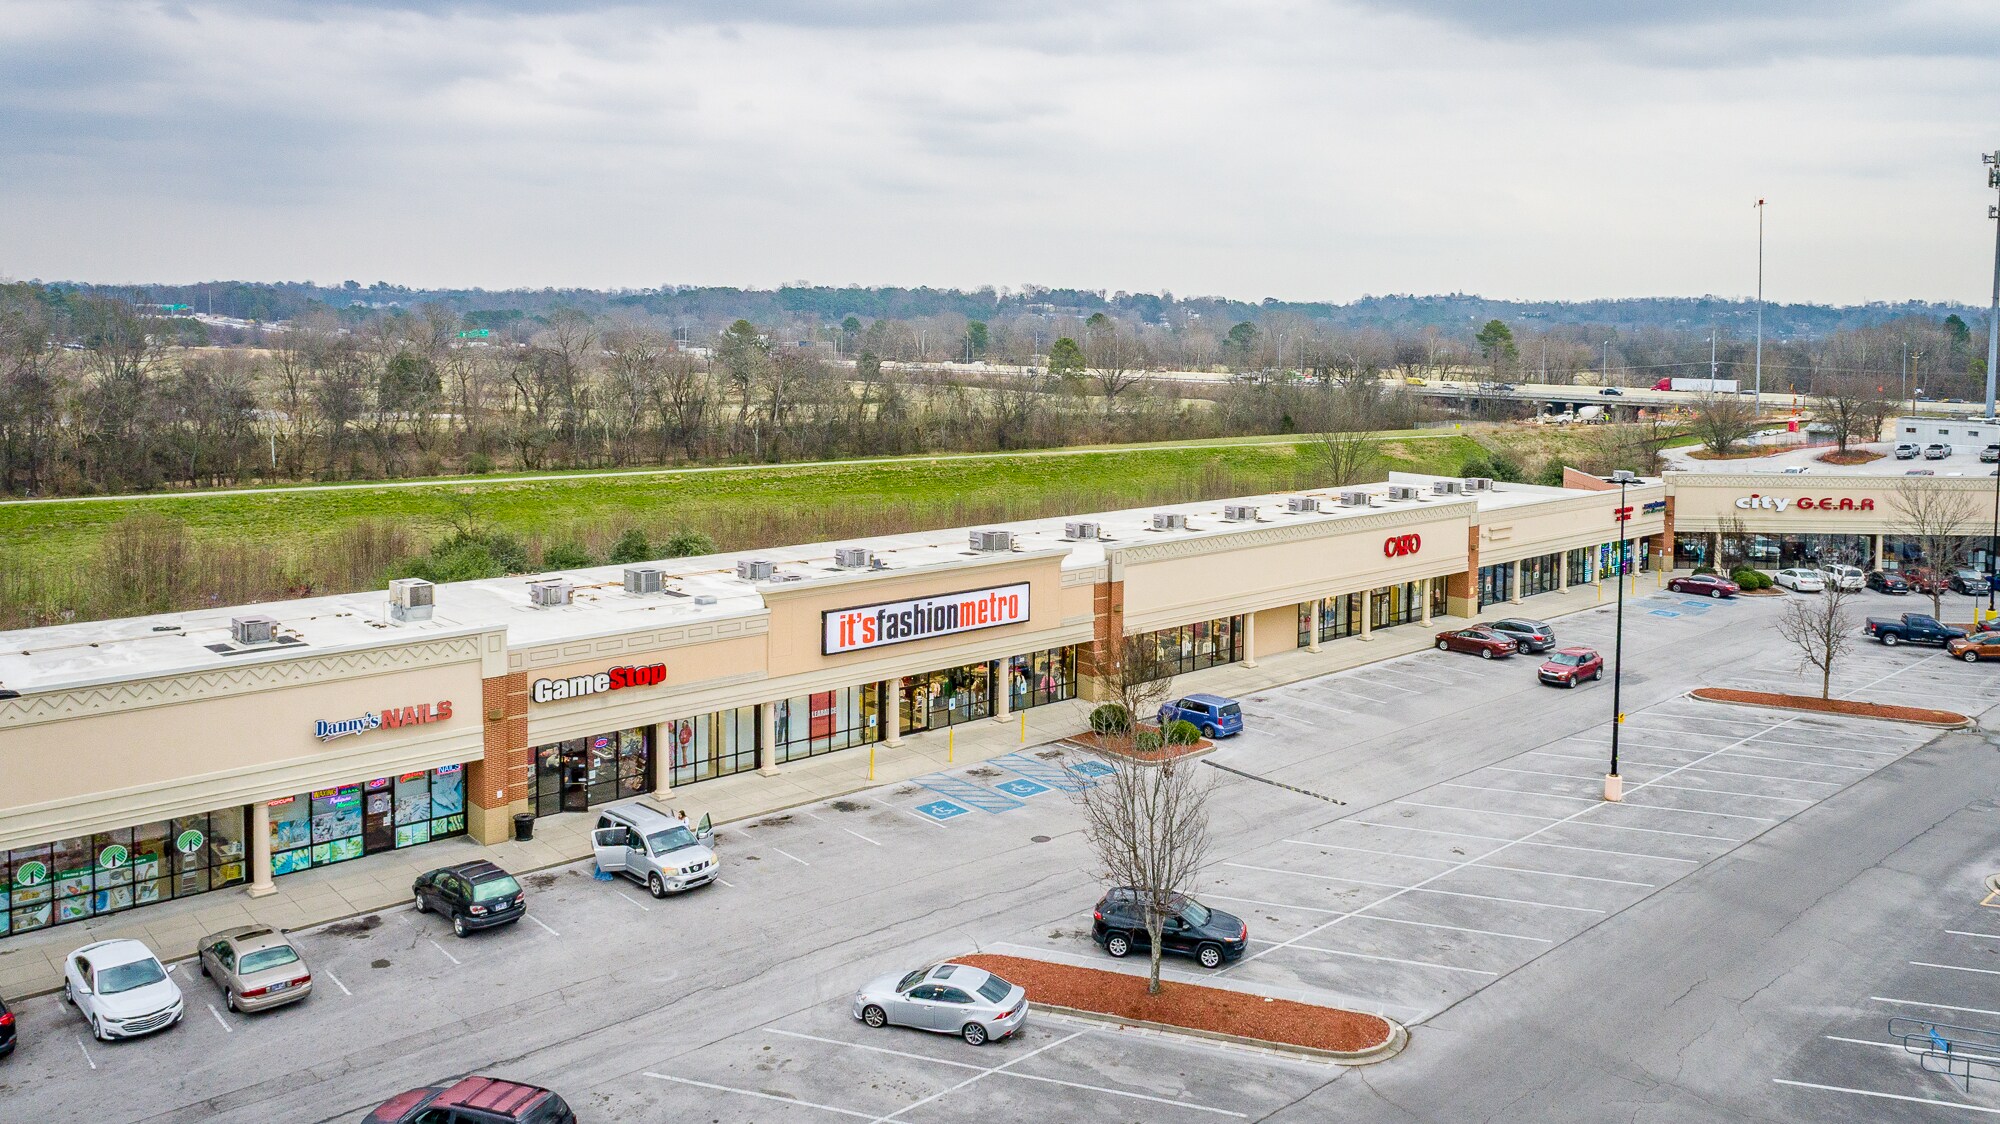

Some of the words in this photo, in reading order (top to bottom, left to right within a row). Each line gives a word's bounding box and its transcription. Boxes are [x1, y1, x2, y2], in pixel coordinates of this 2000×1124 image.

[1735, 494, 1790, 512] city
[1797, 497, 1874, 511] G.E.A.R
[1384, 533, 1421, 558] CATO
[533, 662, 667, 704] GameStop
[315, 711, 381, 737] Danny's
[381, 700, 453, 730] NAILS
